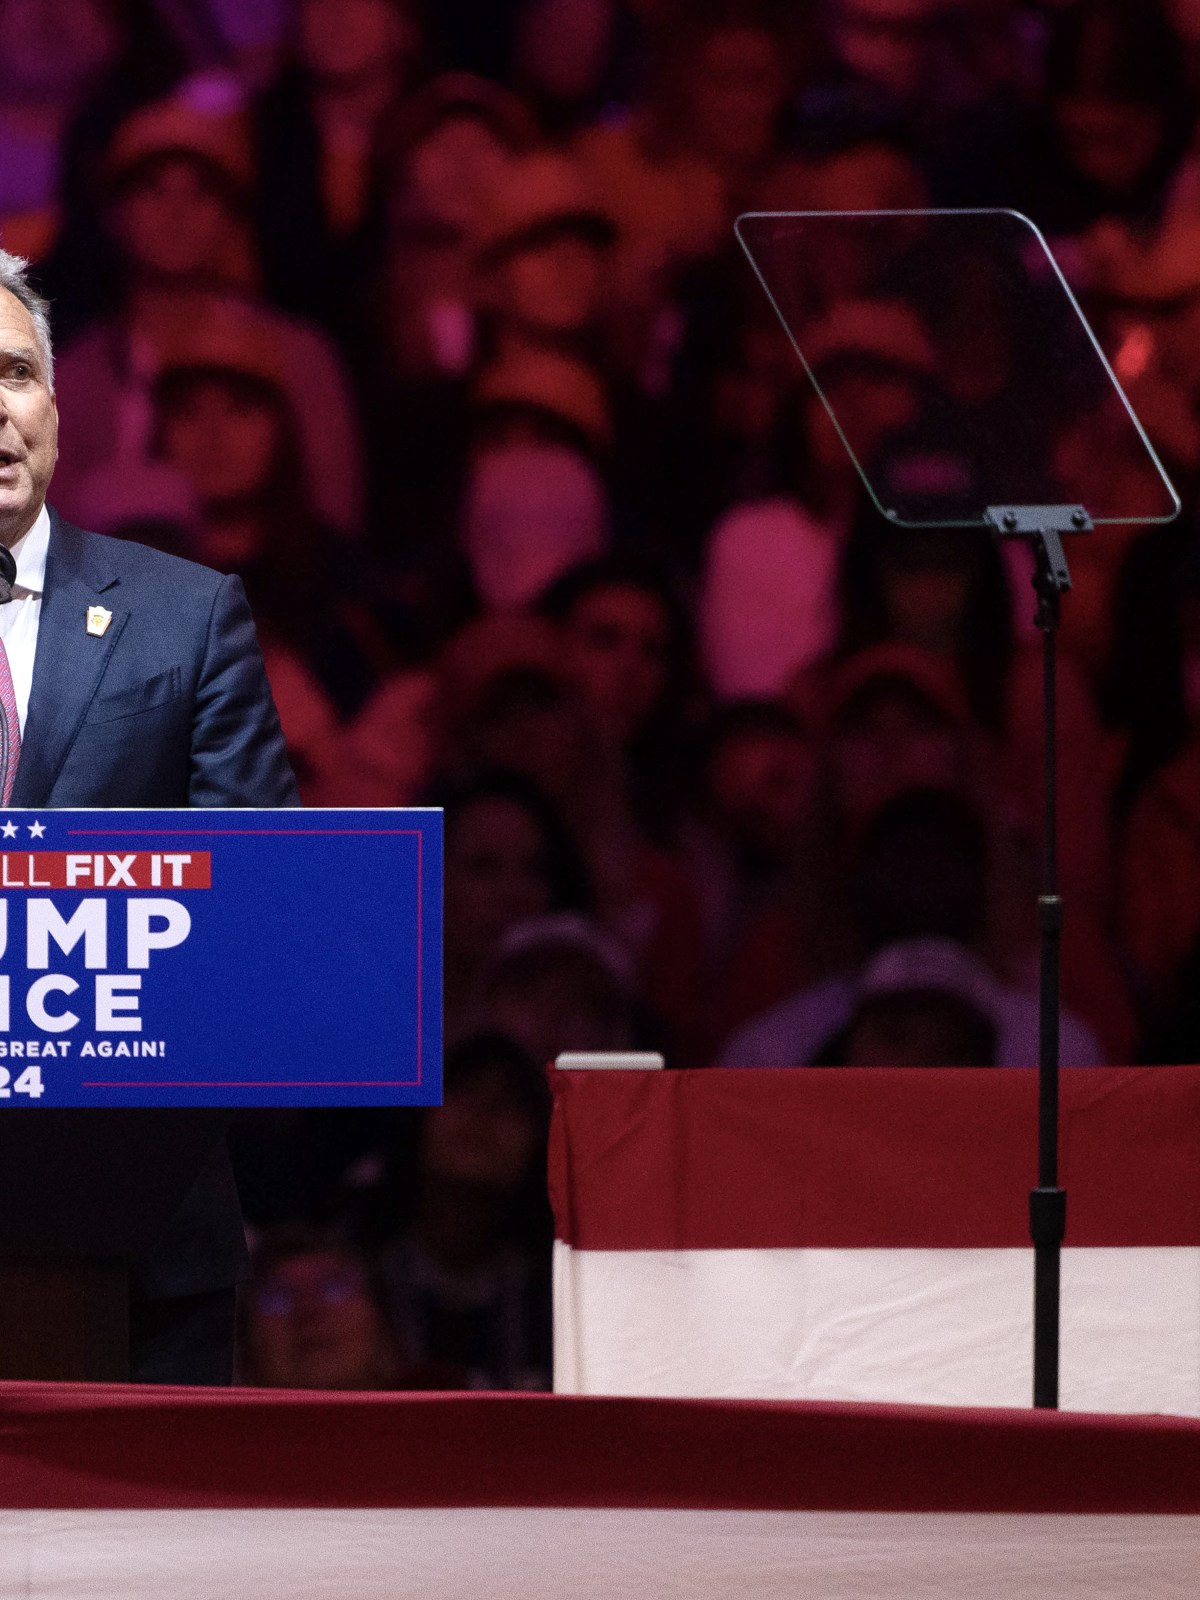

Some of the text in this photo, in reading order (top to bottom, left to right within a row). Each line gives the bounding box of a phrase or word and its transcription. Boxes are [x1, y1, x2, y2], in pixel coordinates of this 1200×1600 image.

[65, 854, 137, 888] FIX
[151, 854, 192, 888] IT
[80, 1040, 166, 1058] AGAIN!
